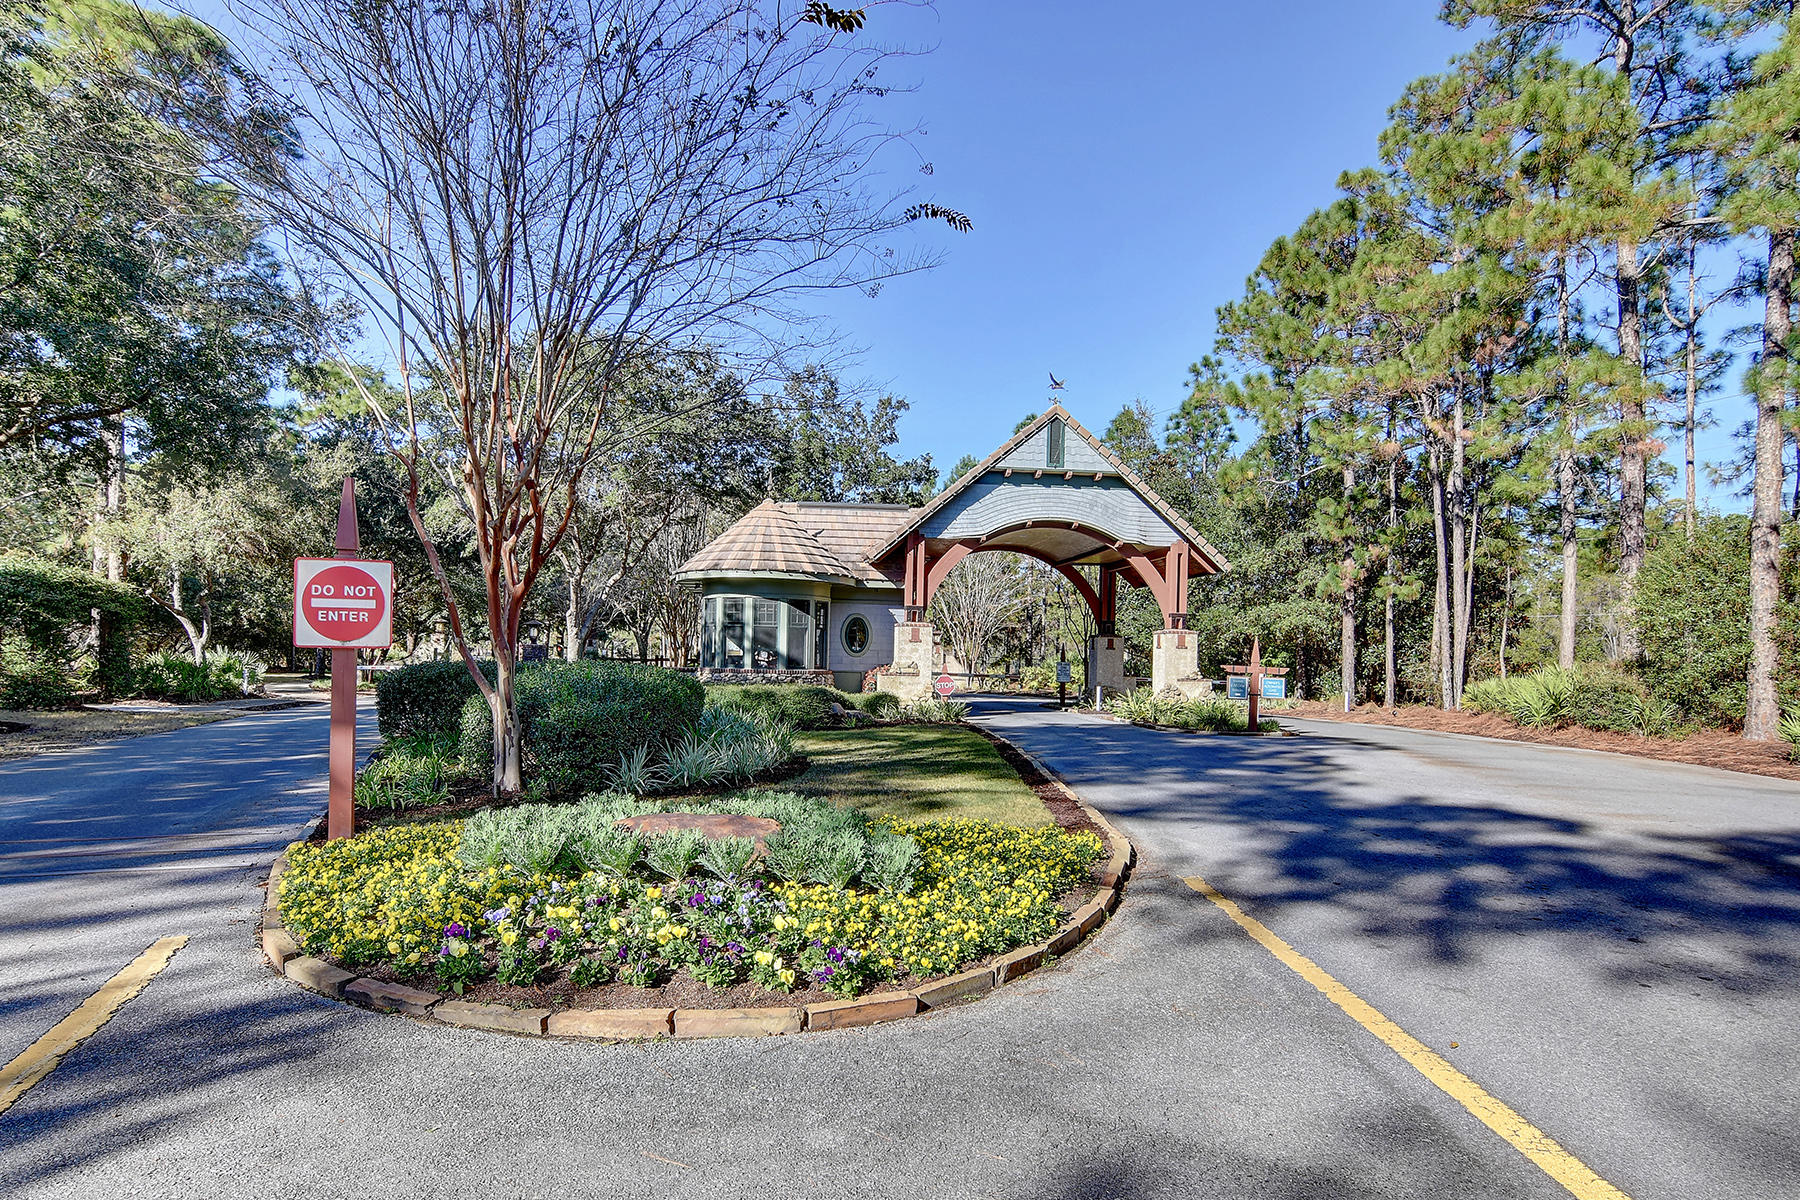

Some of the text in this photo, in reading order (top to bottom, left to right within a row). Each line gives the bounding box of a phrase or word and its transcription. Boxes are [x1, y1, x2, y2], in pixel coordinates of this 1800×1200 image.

[311, 584, 376, 597] DO NOT
[318, 610, 369, 622] ENTER
